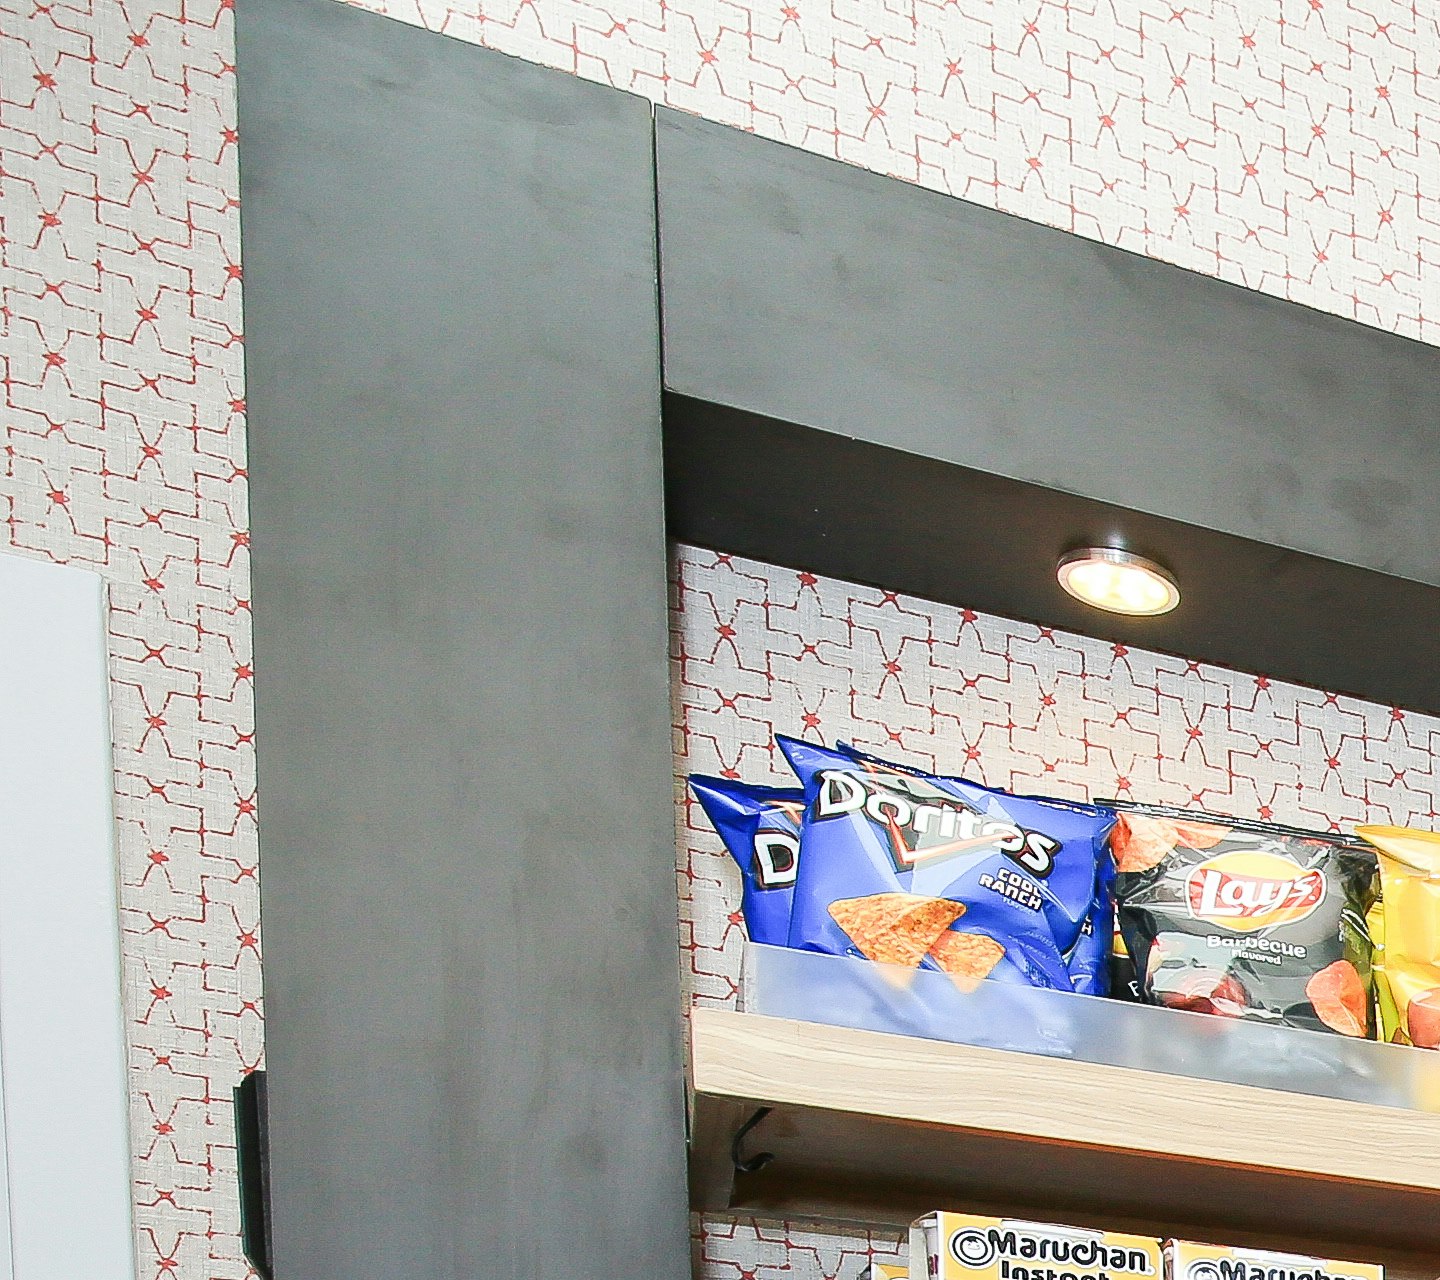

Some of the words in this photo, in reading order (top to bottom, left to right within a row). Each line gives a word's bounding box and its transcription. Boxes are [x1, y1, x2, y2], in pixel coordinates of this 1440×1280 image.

[816, 769, 1061, 877] Doritos
[979, 874, 1042, 910] RANCH
[1199, 870, 1316, 918] Lay's
[1206, 935, 1307, 958] Barbecue
[1232, 950, 1281, 965] Flavored
[987, 1229, 1146, 1272] Maruchan
